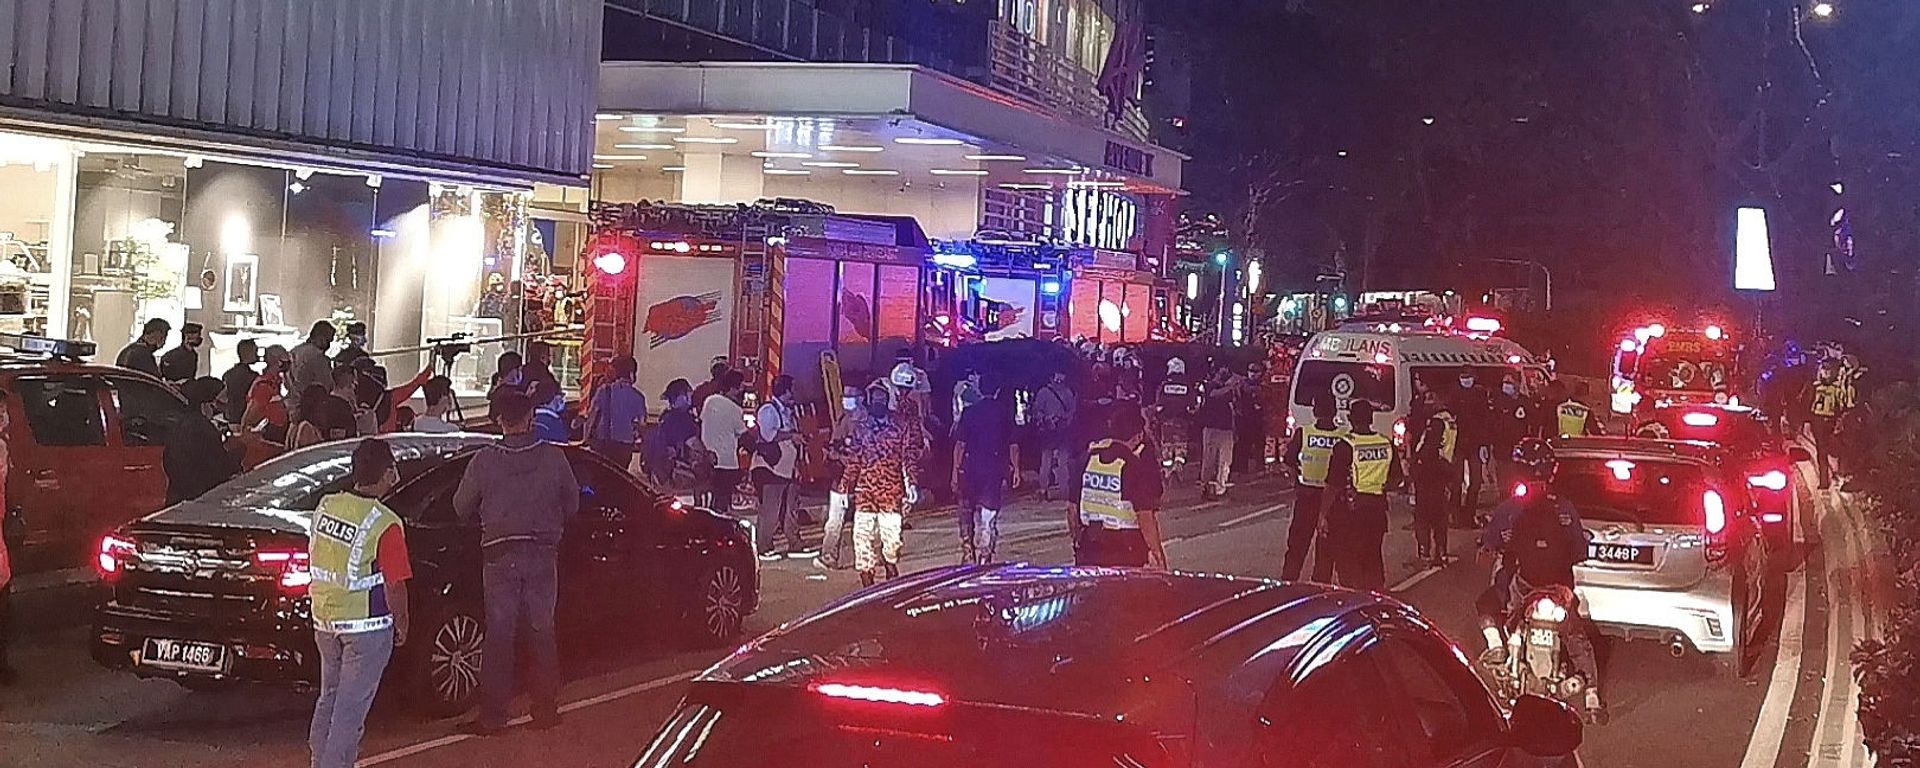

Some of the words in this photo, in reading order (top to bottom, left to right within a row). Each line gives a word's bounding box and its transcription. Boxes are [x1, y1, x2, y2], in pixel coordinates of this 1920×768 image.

[1309, 436, 1337, 448] POLI
[1083, 473, 1121, 491] POLIS
[318, 517, 355, 541] POLIS
